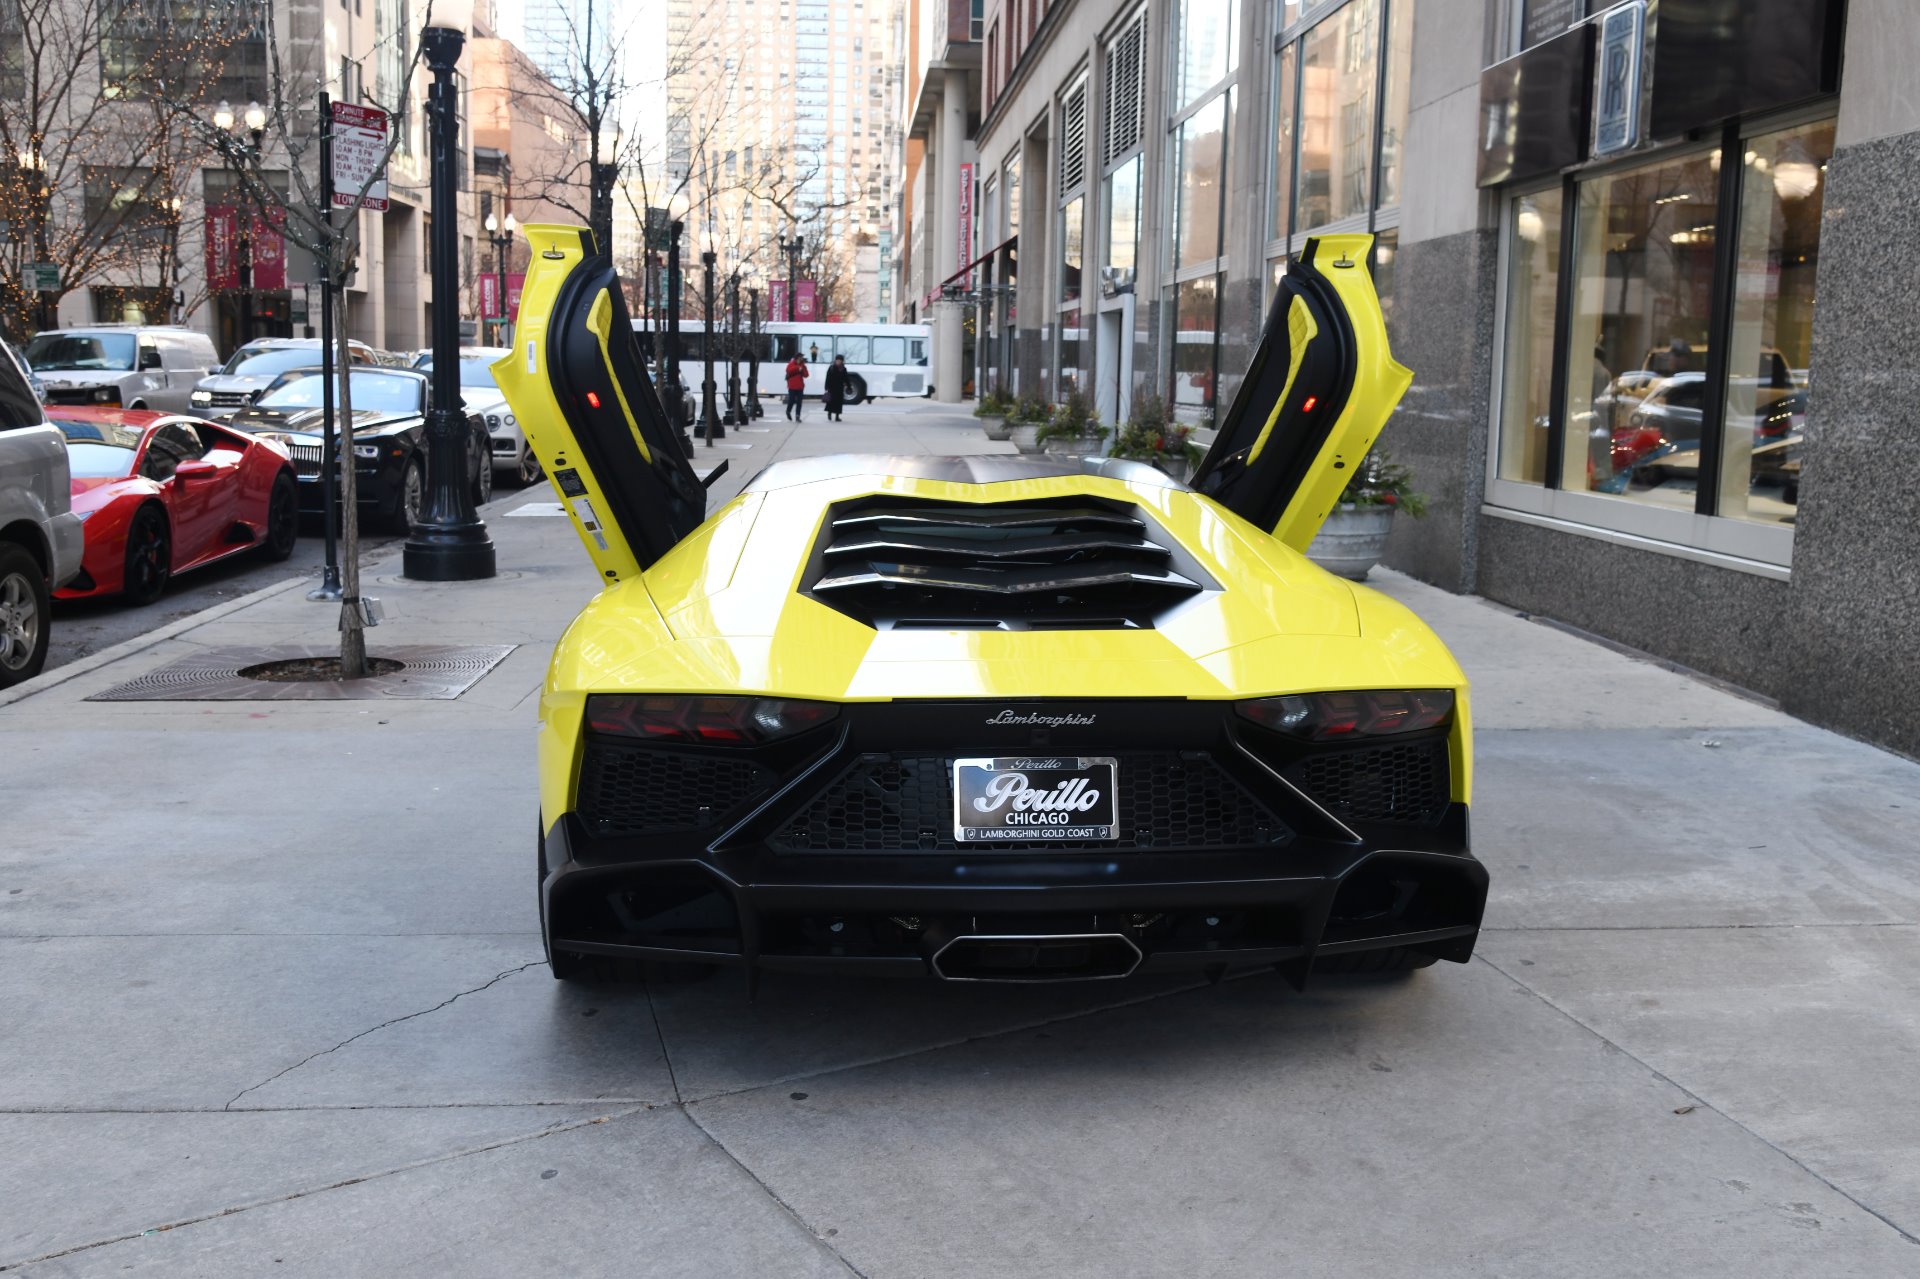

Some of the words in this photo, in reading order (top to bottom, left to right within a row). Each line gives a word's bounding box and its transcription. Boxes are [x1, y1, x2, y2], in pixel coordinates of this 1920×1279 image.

[335, 104, 341, 112] 15
[343, 106, 364, 117] MINUTE
[335, 127, 347, 136] USE
[335, 135, 365, 148] FLASHING
[335, 153, 349, 162] MON
[343, 146, 353, 154] AM
[364, 149, 373, 157] PM
[335, 162, 342, 170] 10
[343, 163, 352, 171] AM
[363, 166, 373, 175] PM
[336, 170, 346, 178] FRI
[351, 173, 364, 182] SUN
[336, 193, 356, 206] TOW
[985, 709, 1097, 728] Lamborghini
[1011, 758, 1062, 770] Perillo
[973, 772, 1100, 813] Perillo
[1005, 812, 1069, 825] CHICAGO
[980, 829, 1040, 839] LAMBORGHINI
[1041, 829, 1065, 838] GOLD
[1067, 828, 1095, 838] COAST
